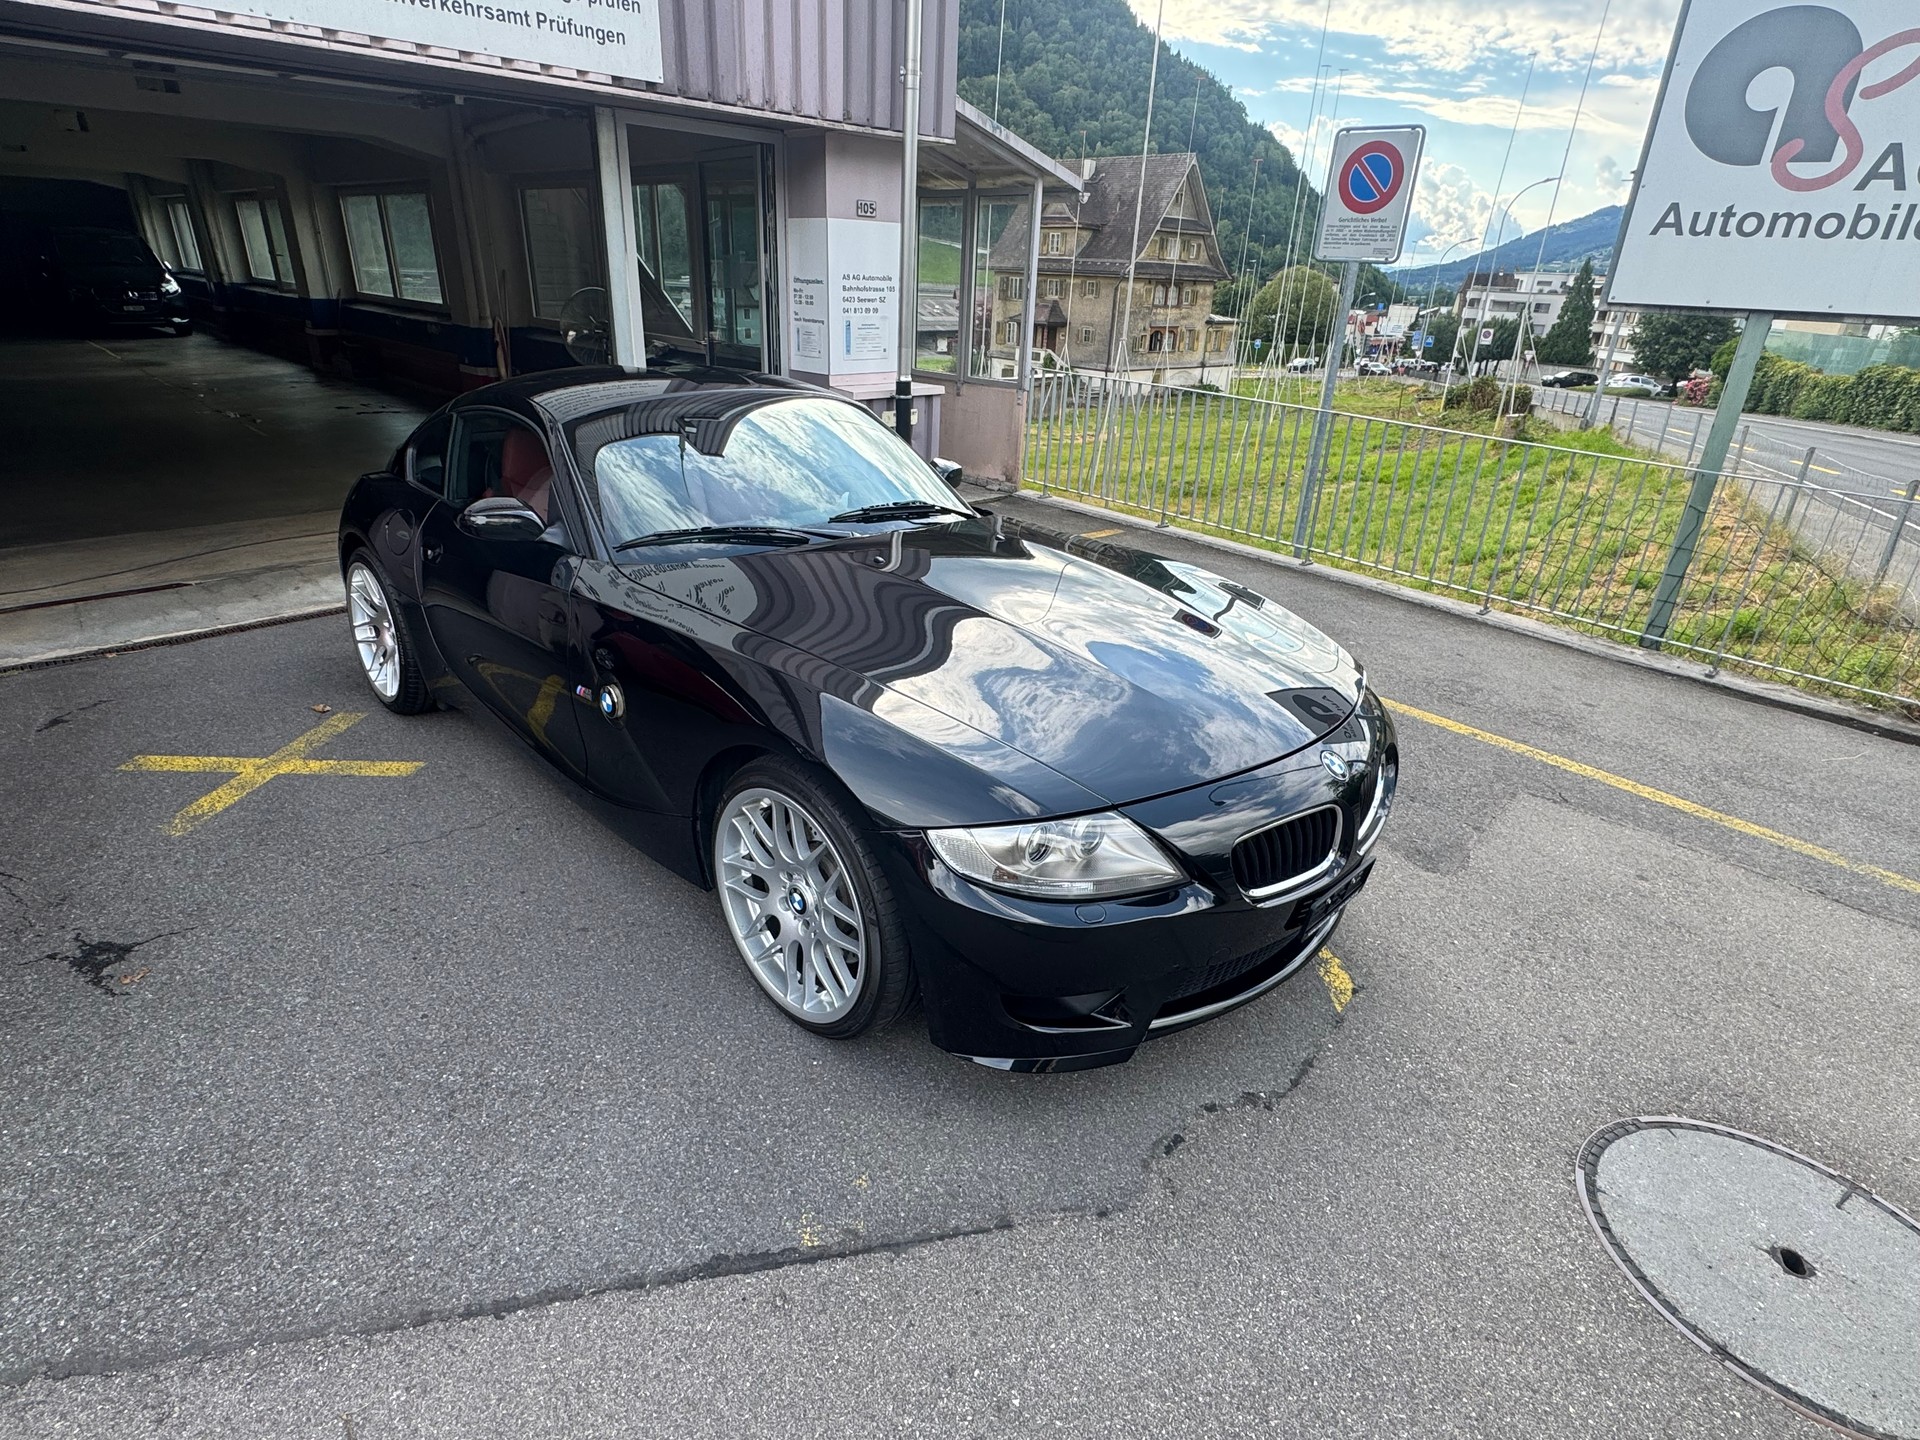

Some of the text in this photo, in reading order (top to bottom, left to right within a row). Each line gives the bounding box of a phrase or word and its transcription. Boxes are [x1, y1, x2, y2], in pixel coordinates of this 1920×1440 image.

[536, 11, 626, 46] Prüfungen
[1852, 142, 1920, 191] A
[859, 202, 876, 215] 105
[1649, 202, 1920, 241] Automobil
[842, 285, 885, 293] Bahnhofstrasse
[862, 274, 893, 282] Automobile
